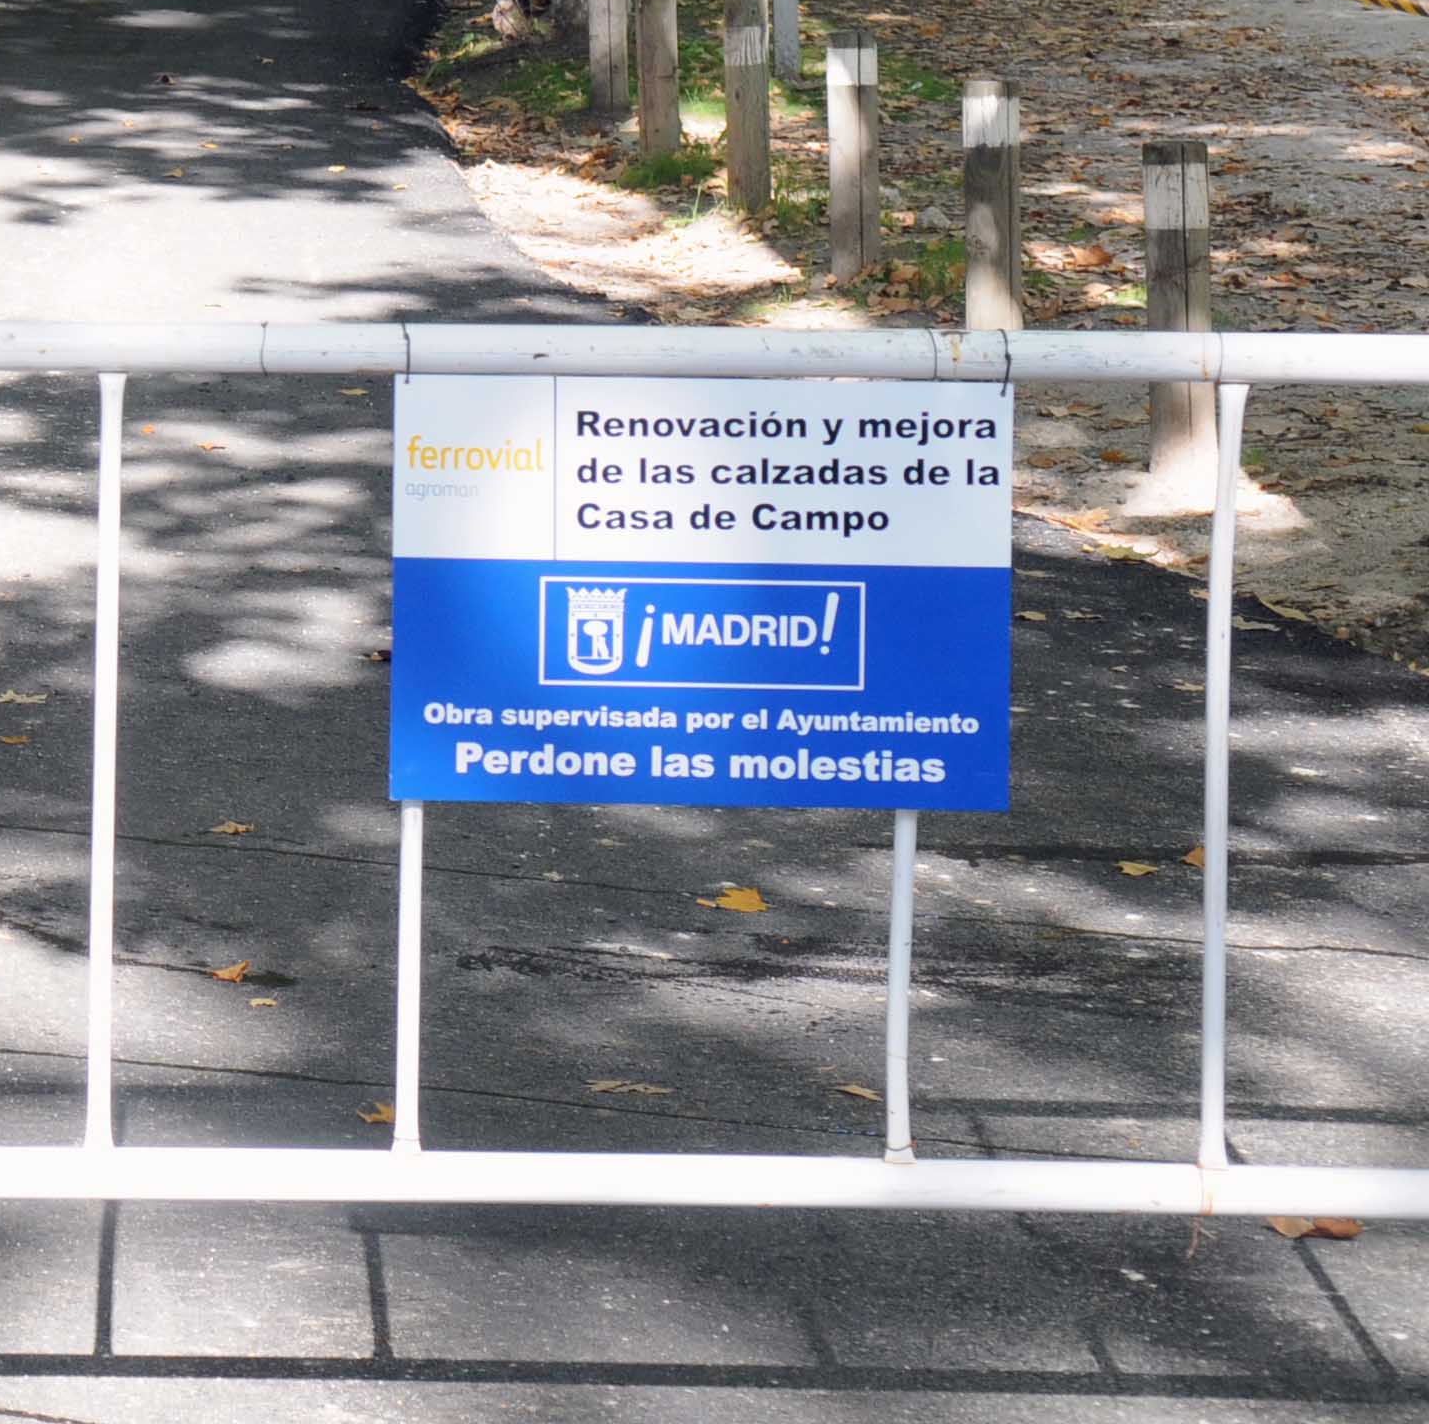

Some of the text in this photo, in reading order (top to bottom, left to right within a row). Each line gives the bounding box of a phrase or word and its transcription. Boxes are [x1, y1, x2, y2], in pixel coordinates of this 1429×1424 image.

[577, 410, 997, 446] Renovación y mejora
[407, 434, 546, 471] ferrovial
[577, 458, 1000, 486] de las calzadas de la
[405, 480, 479, 502] agroman
[577, 503, 890, 538] Casa de Campo
[423, 702, 980, 736] Obra supervisada por el Ayuntamiento
[455, 742, 947, 783] Perdone las molestias
